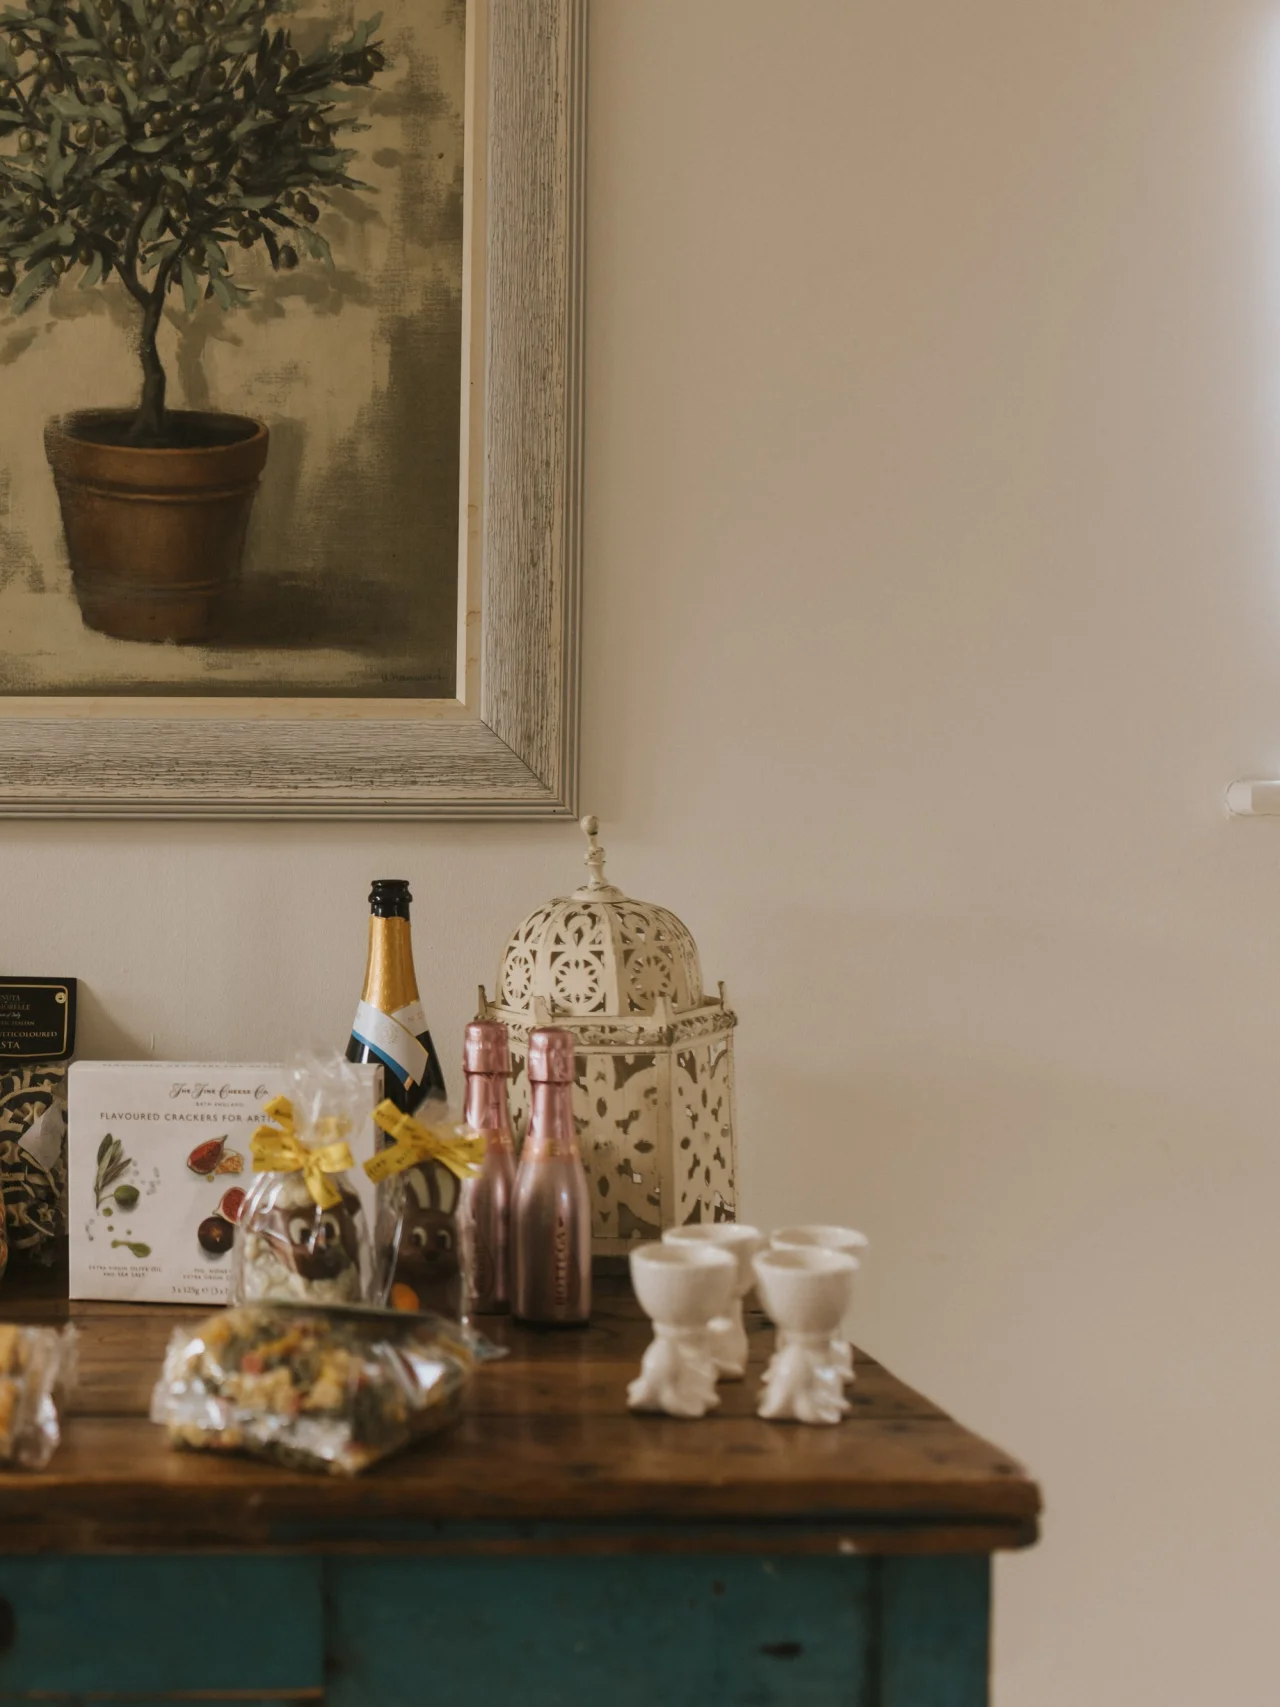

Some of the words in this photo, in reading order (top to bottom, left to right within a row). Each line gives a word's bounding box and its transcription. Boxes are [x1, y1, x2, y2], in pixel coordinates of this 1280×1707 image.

[100, 1112, 160, 1121] FLAVOURED
[164, 1113, 218, 1122] CRACKERS
[222, 1114, 242, 1122] FOR
[183, 1286, 200, 1296] 125g
